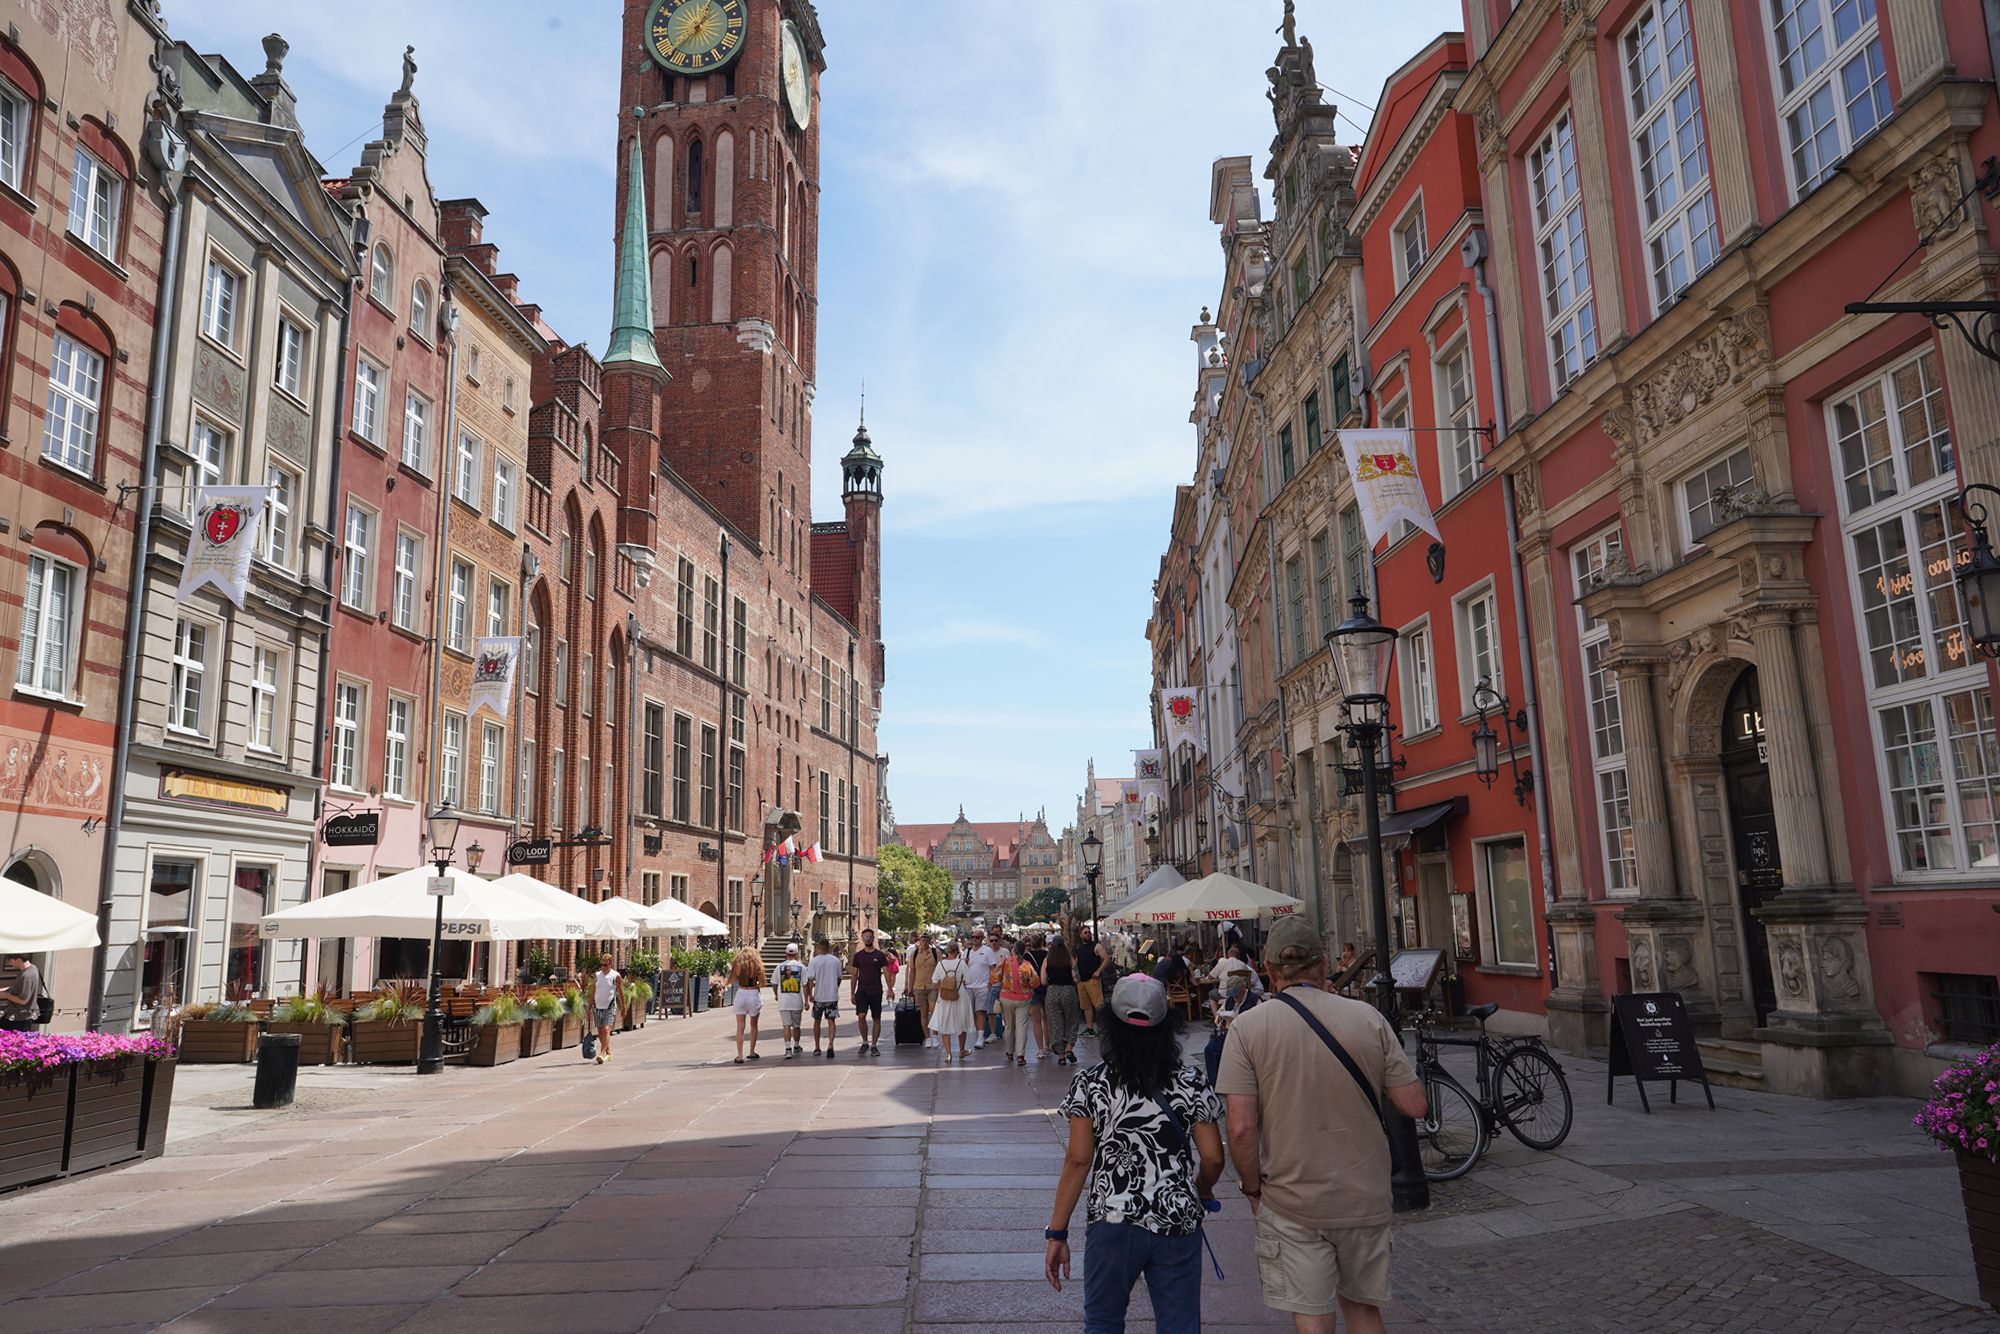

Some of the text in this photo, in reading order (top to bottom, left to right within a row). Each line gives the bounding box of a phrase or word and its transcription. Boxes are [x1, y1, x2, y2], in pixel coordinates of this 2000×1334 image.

[328, 823, 376, 834] HOKKAIDŌ
[526, 847, 548, 856] LODY
[1205, 909, 1241, 919] TYSKIE
[1270, 904, 1295, 915] TYSKIE
[1151, 912, 1176, 921] TYSKIE
[440, 922, 481, 934] PEPSI
[566, 924, 585, 934] PEPSI
